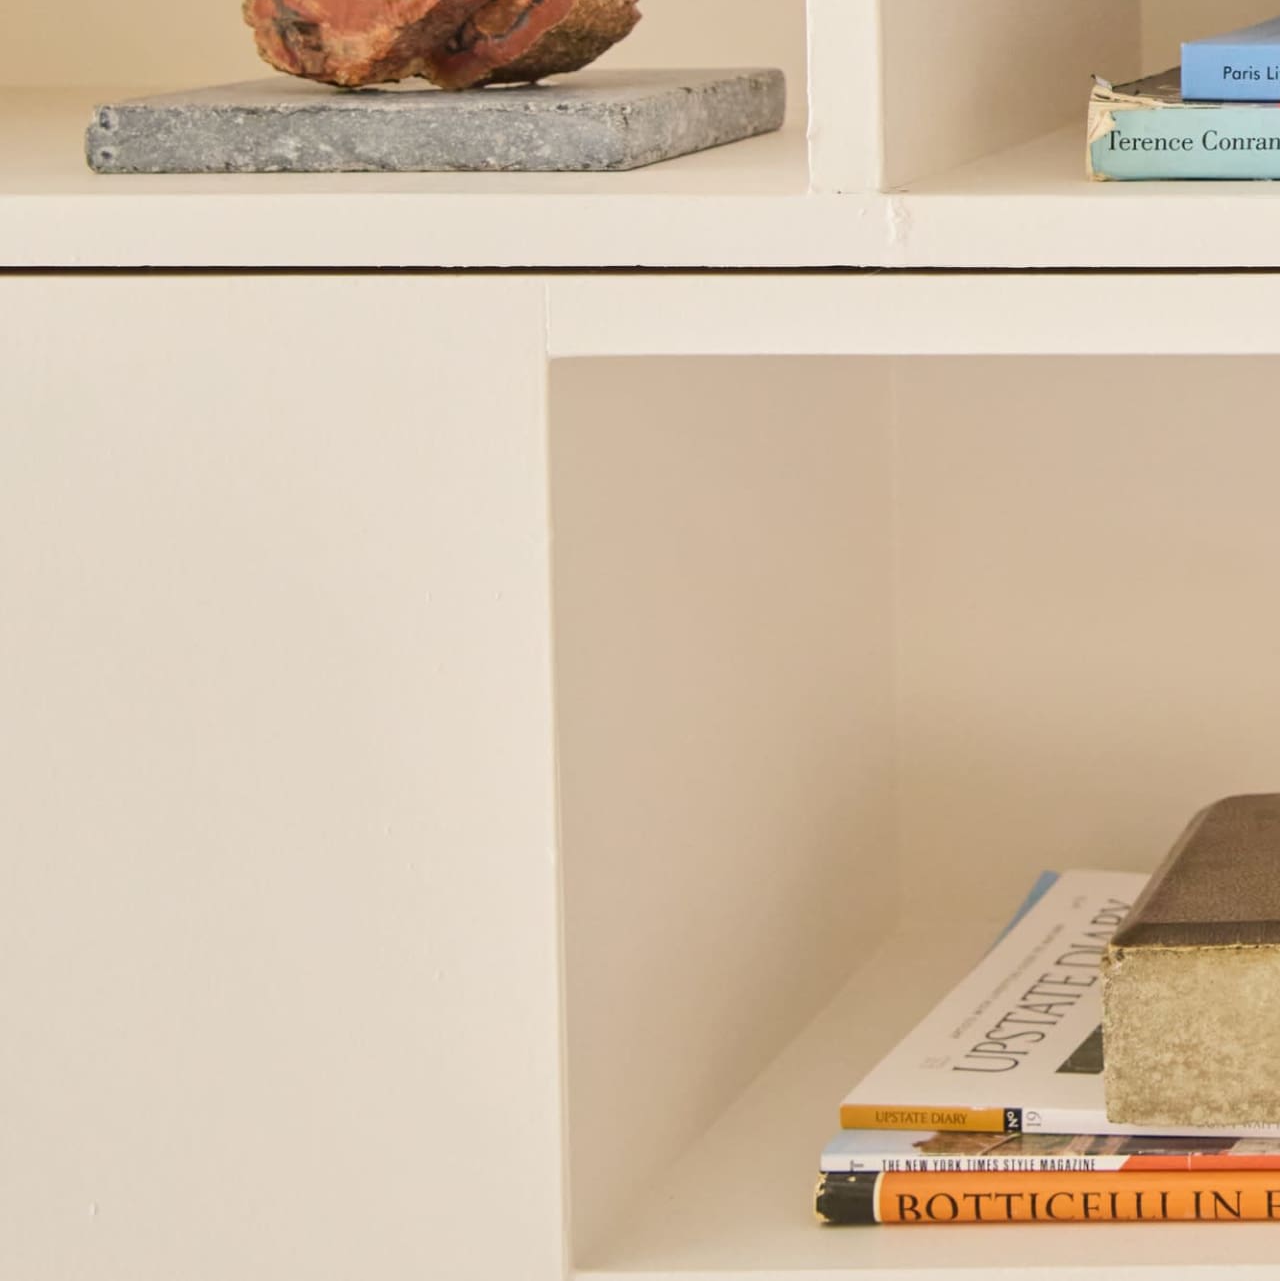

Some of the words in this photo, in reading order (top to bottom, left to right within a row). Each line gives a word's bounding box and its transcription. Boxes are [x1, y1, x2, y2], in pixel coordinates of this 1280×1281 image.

[1222, 66, 1261, 81] Paris
[1106, 130, 1193, 151] Terence
[951, 972, 1098, 1073] UPSTATE
[875, 1110, 929, 1124] UPSTATE
[930, 1111, 968, 1125] DIARY
[882, 1159, 903, 1171] THE
[906, 1159, 928, 1171] NEW
[933, 1159, 961, 1171] YORK
[967, 1159, 999, 1171] TIMES
[1003, 1159, 1036, 1171] STYLE
[1040, 1159, 1096, 1172] MAGAZINE
[895, 1191, 1170, 1220] BOTTICELLI
[1193, 1190, 1242, 1219] IN
